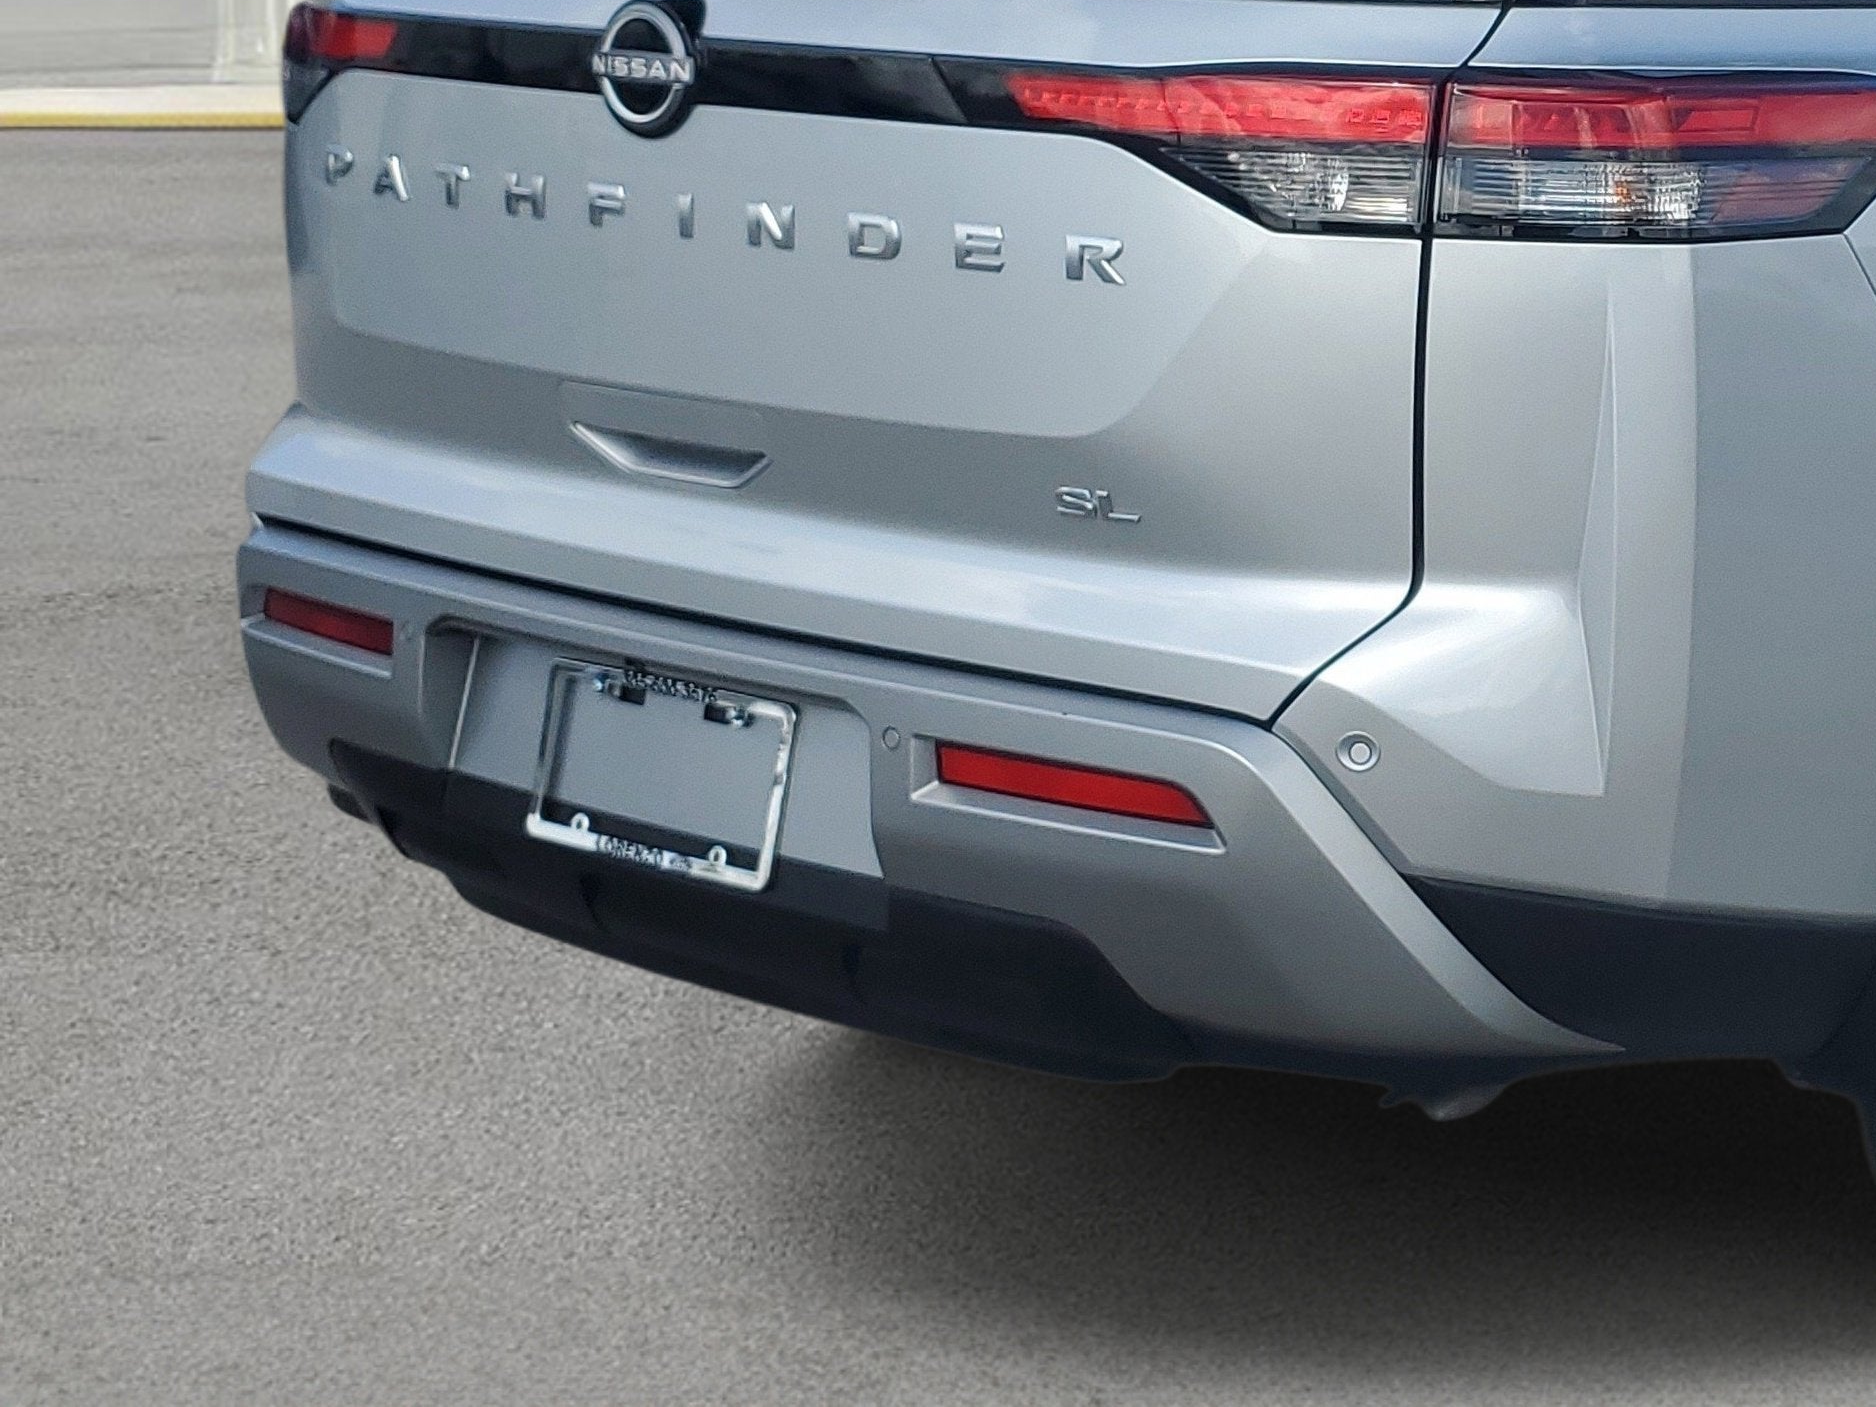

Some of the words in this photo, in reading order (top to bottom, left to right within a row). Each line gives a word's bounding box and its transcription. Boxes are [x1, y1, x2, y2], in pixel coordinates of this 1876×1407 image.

[592, 54, 691, 83] NISSAN
[324, 149, 1125, 285] PATHFINDER
[1055, 486, 1141, 522] SL
